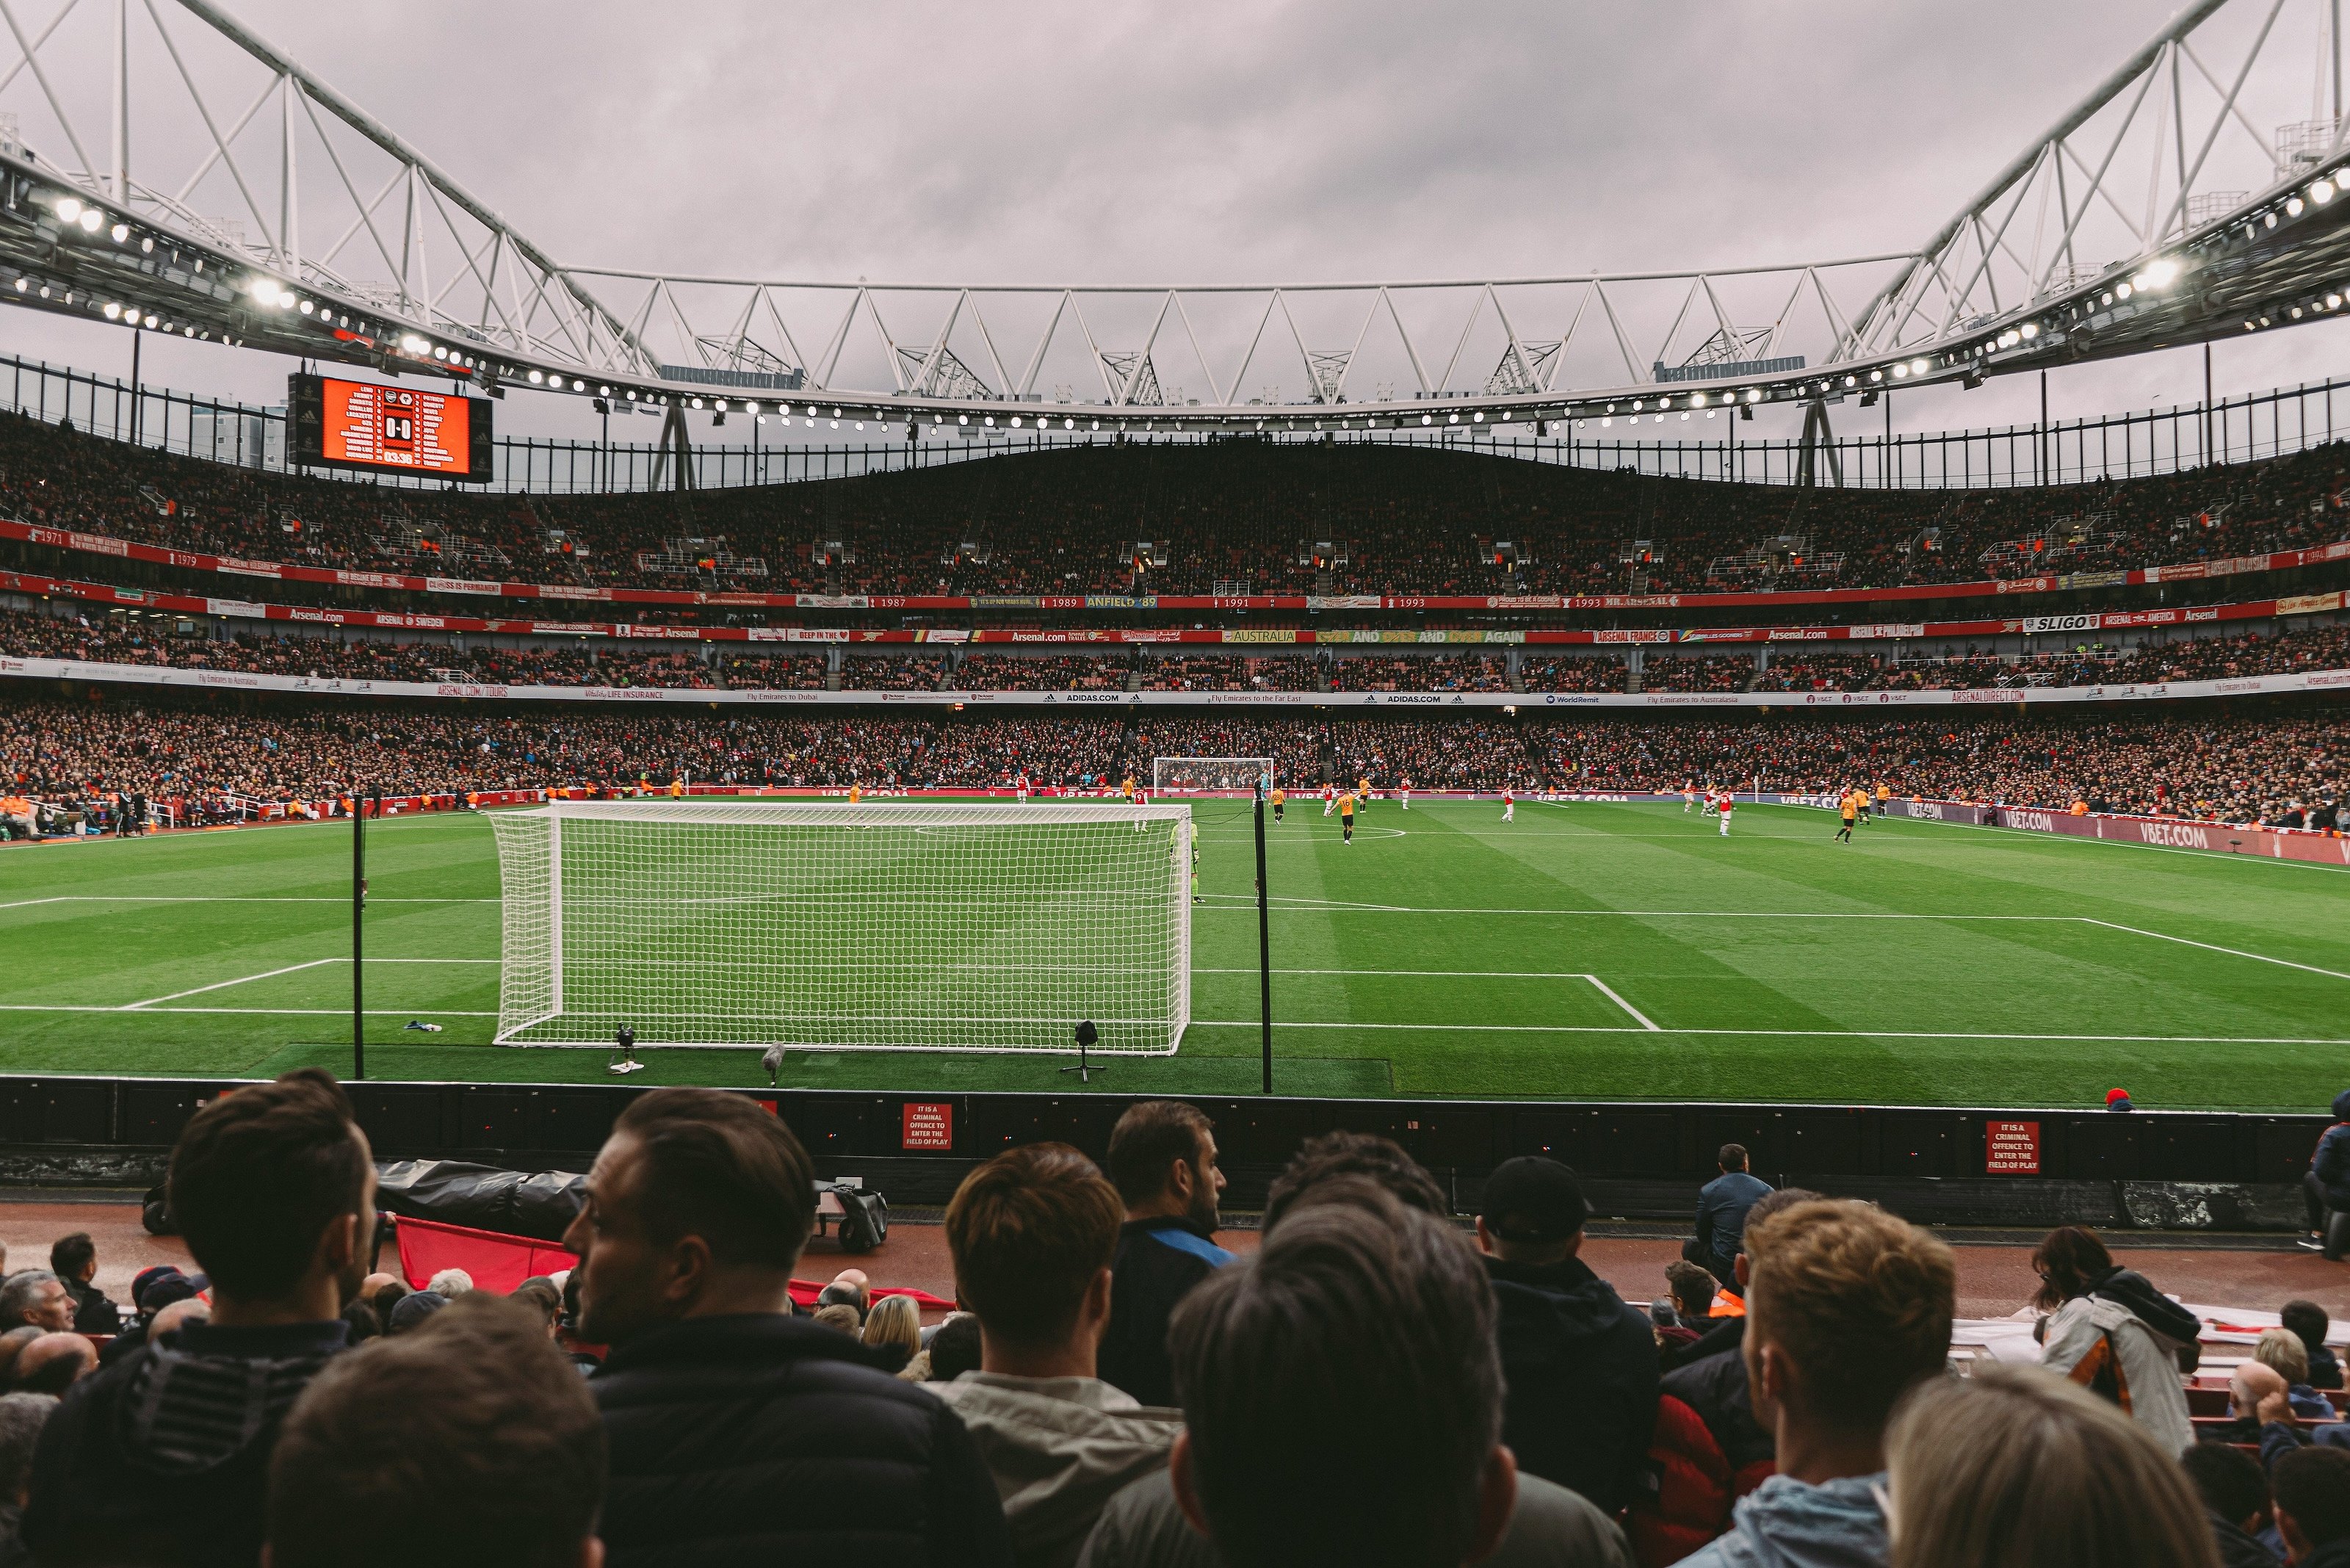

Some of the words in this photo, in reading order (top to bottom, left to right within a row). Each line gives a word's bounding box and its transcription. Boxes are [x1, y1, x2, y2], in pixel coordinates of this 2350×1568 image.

[384, 451, 413, 465] 03:36
[42, 530, 62, 544] 1971
[178, 554, 197, 566] 1979
[2307, 551, 2325, 563] 1994
[2210, 560, 2234, 577] ARSENAL
[2236, 556, 2264, 574] MALAYSIA
[463, 583, 499, 592] PERMANENT
[881, 599, 906, 607] 1987
[1052, 599, 1077, 607] 1989
[1088, 597, 1135, 607] ANFIELD
[1224, 599, 1248, 607] 1991
[1400, 599, 1425, 608] 1993
[1575, 599, 1600, 608] 1993
[290, 608, 344, 623] Arsenal.com
[2105, 614, 2132, 626] ARSENAL
[2147, 611, 2175, 624] AMERICA
[2184, 608, 2219, 621] Arsenal
[377, 614, 403, 625] ARSENAL
[416, 617, 444, 628] SWEDEN
[2037, 616, 2086, 631] SLIGO
[665, 628, 699, 638] Arsenal
[1012, 632, 1066, 642] Arsenal.com
[1234, 631, 1295, 642] AUSTRALIA
[1317, 632, 1349, 642] OVER
[1352, 632, 1379, 643] AND
[1383, 632, 1415, 643] OVER
[1418, 632, 1446, 643] AND
[1449, 632, 1482, 643] OVER
[1484, 632, 1525, 643] AGAIN
[1597, 632, 1629, 642] ARSENAL
[1630, 631, 1657, 642] FRANCE
[1768, 629, 1827, 640] Arsenal.com
[1849, 626, 1874, 638] ARSENAL
[207, 673, 226, 684] Emirates
[228, 676, 233, 684] to
[234, 676, 258, 685] Australasia
[438, 684, 508, 697] ARSENAL.COM/TOURS
[585, 689, 607, 700] Vitality
[607, 690, 621, 698] LIFE
[623, 690, 664, 699] INSURANCE
[1952, 690, 2025, 702] ARSENALDIRECT.COM
[748, 693, 758, 702] Fly
[1212, 695, 1221, 704] Fly
[1699, 696, 1738, 704] Australasia
[1136, 793, 1142, 801] 9
[1342, 799, 1350, 807] 16
[2005, 810, 2053, 832] VBET.COM
[2140, 822, 2208, 850] VBET.COM
